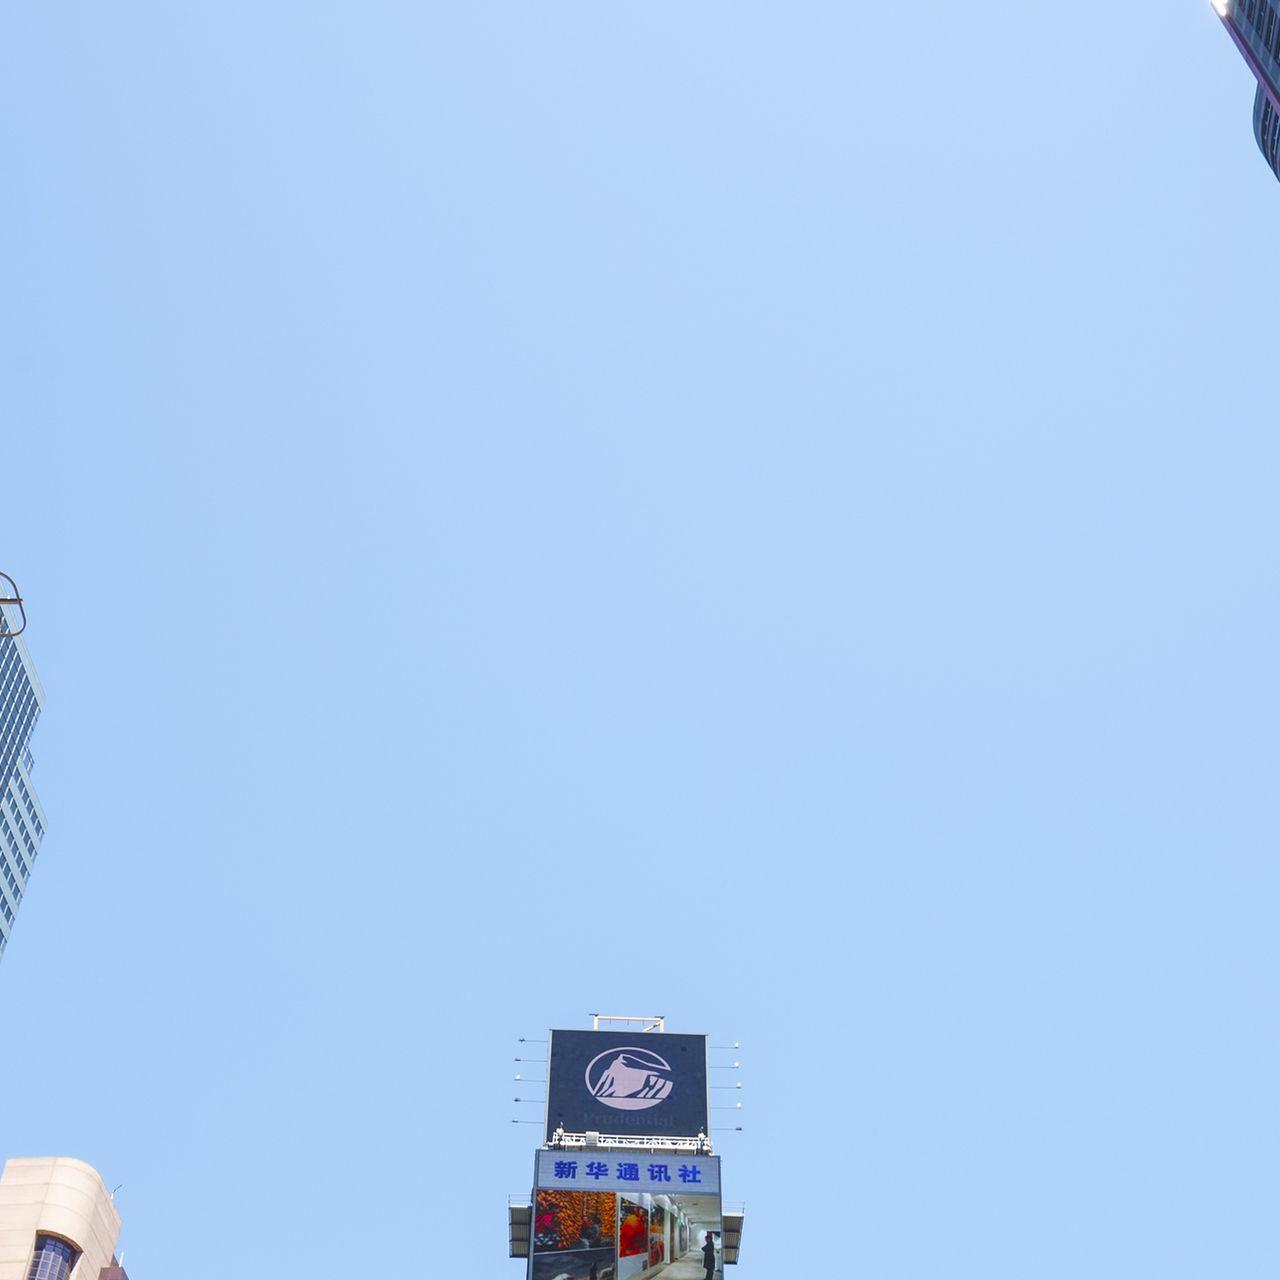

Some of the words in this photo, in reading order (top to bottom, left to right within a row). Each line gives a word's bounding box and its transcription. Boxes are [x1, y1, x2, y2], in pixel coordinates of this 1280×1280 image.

[554, 1160, 702, 1184] 新华通讯社
